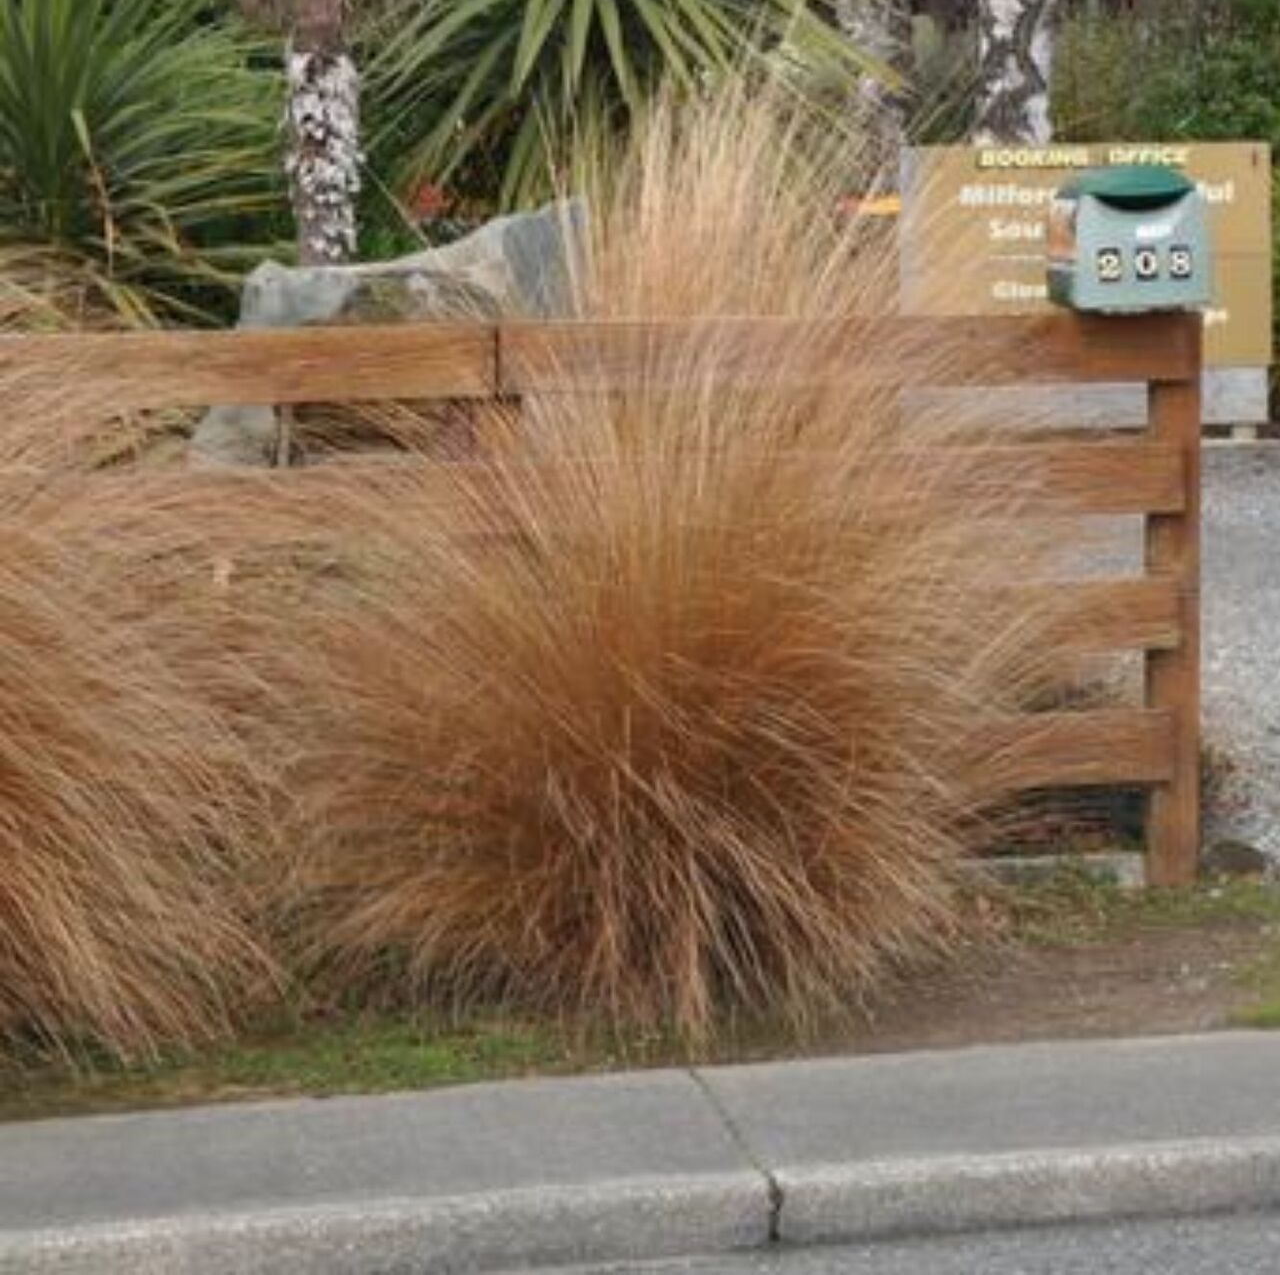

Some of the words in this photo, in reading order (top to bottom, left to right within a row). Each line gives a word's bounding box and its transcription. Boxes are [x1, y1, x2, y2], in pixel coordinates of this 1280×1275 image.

[979, 147, 1089, 168] BOOKING
[1108, 145, 1190, 166] OFFICE
[1098, 250, 1192, 280] 208
